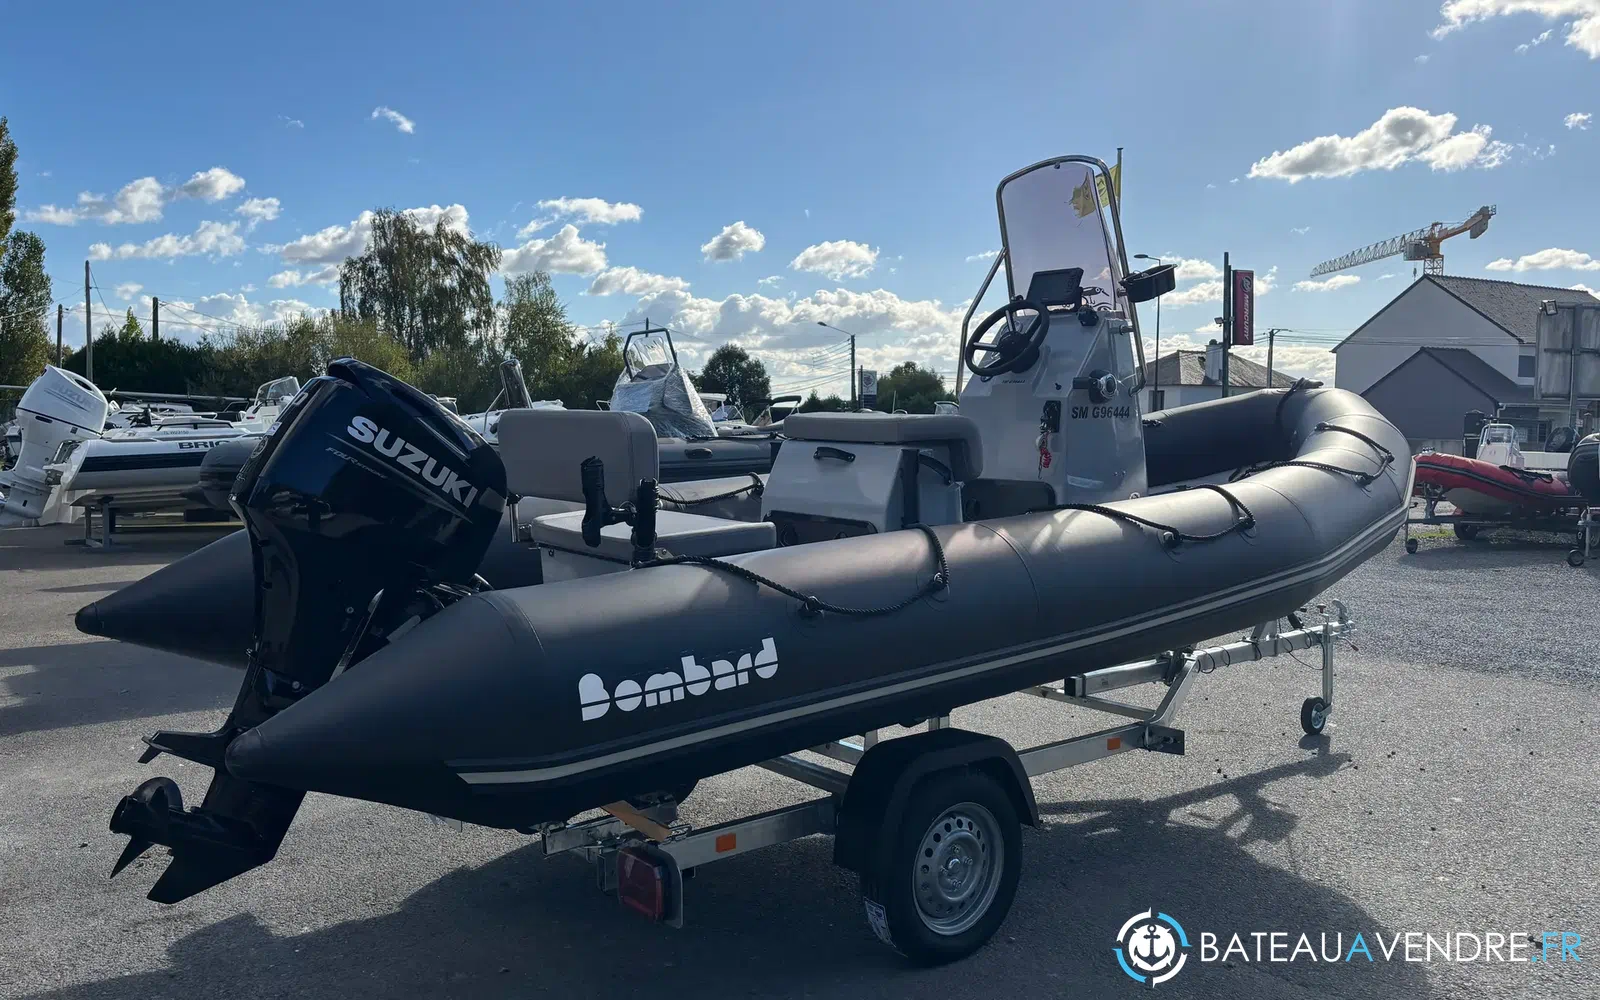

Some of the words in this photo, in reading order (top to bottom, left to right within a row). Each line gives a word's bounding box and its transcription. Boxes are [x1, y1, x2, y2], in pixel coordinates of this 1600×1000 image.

[1071, 406, 1089, 419] SM
[1092, 406, 1130, 419] G96444
[347, 415, 479, 508] SUZUKI
[578, 637, 779, 722] Bombard
